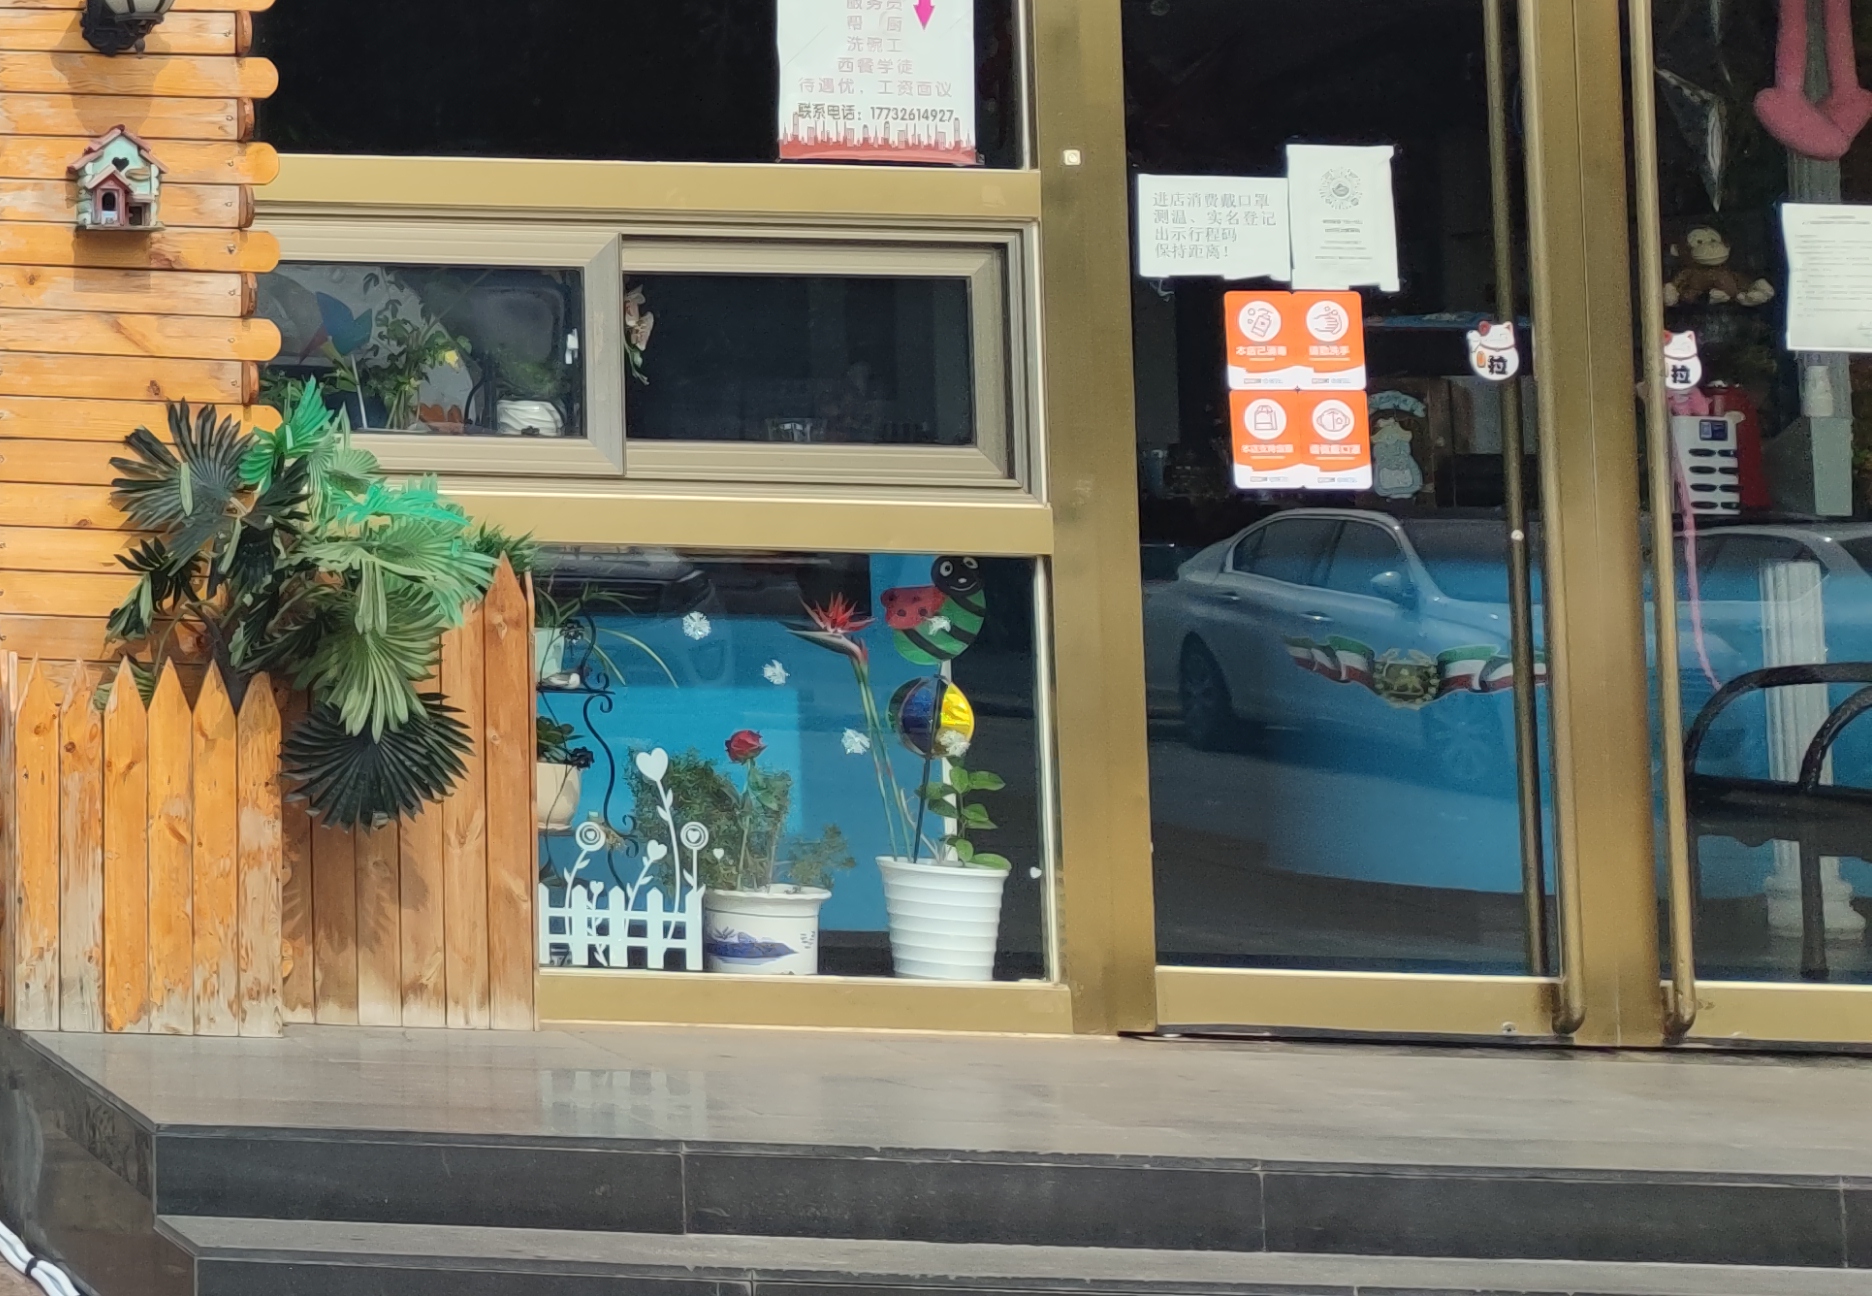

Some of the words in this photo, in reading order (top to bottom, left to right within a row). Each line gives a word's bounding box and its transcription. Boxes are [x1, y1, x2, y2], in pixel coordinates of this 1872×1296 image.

[847, 36, 902, 52] 洗碗工
[837, 57, 913, 74] 西餐学徒
[1153, 192, 1269, 208] 进店消费戴口罩
[1156, 226, 1237, 242] 出示行程码
[1488, 356, 1508, 375] 拉
[1671, 365, 1691, 384] 拉
